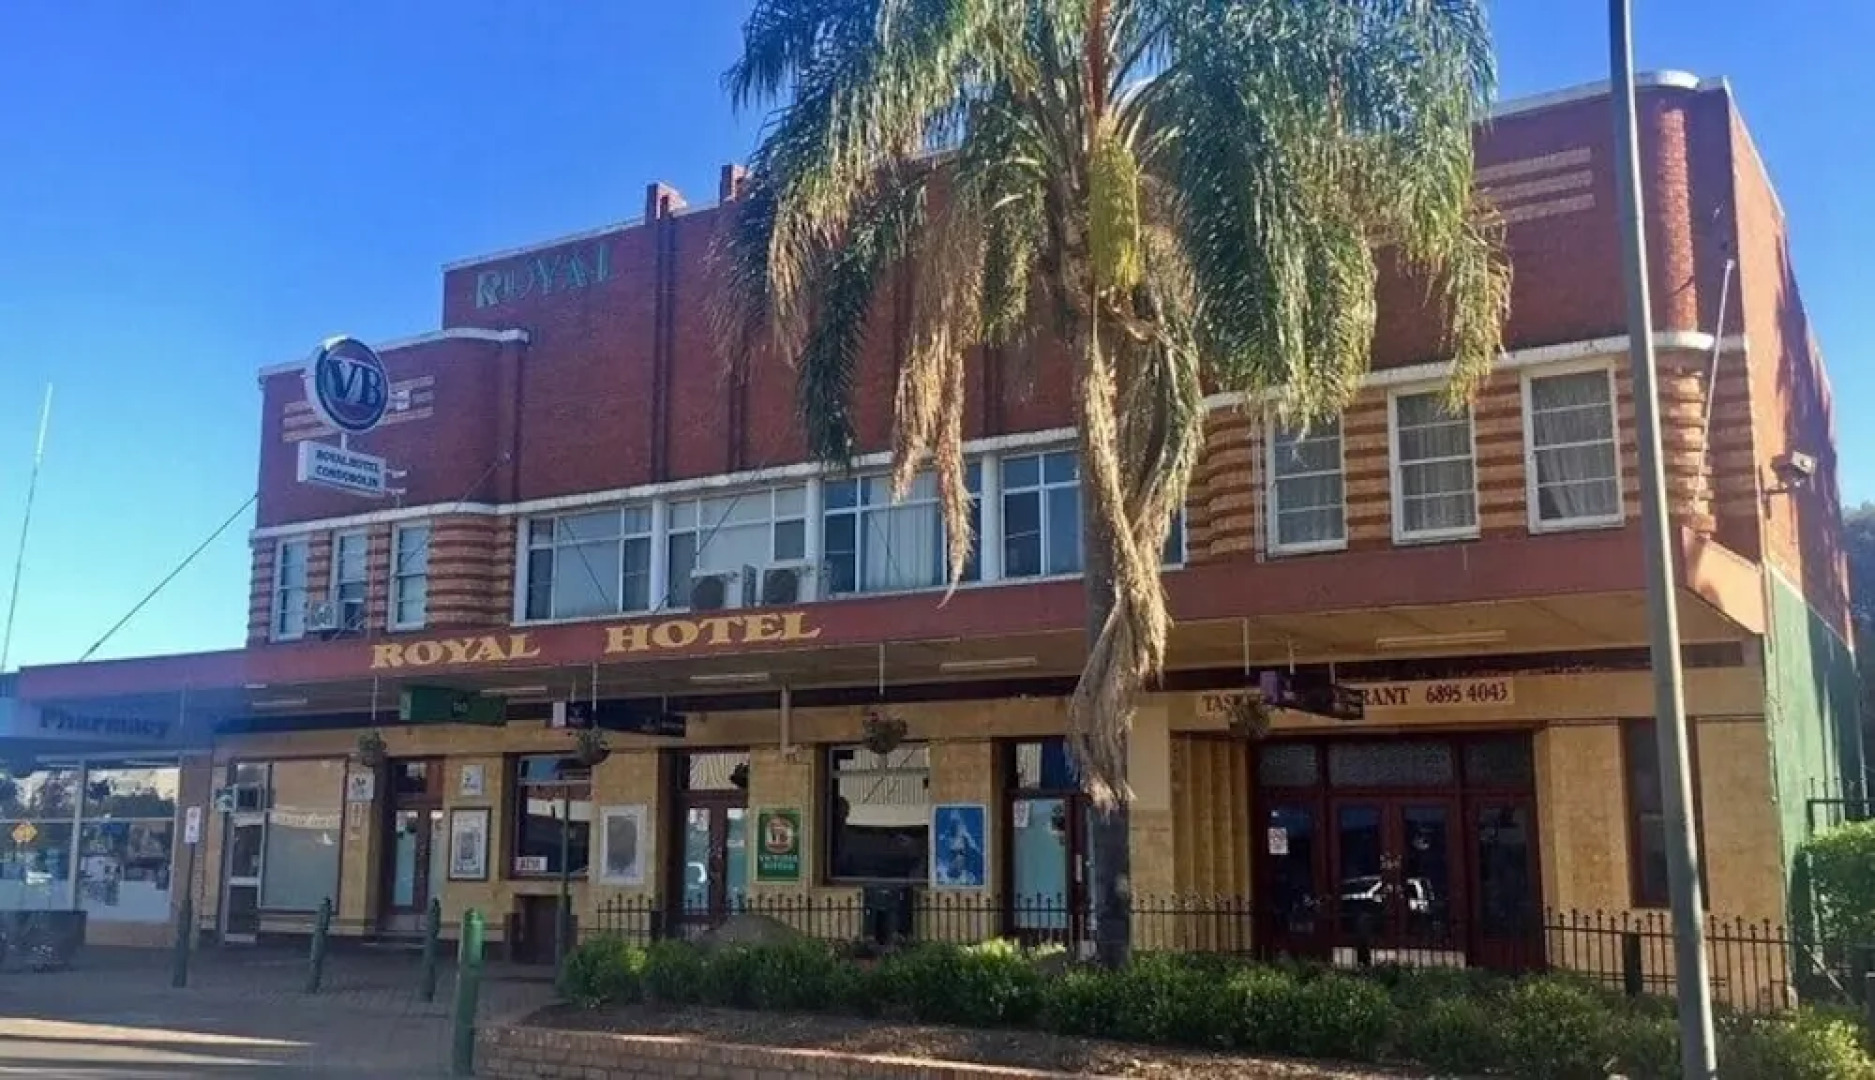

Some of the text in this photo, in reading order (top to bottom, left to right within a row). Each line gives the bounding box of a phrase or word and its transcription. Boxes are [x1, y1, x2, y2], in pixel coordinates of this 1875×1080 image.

[326, 357, 382, 406] VB
[315, 449, 347, 465] ROYAL
[315, 464, 379, 487] CONDOBOLIN
[369, 612, 822, 669] ROYAL HOTEL
[1425, 683, 1463, 704] 6895
[1466, 681, 1508, 704] 4043
[40, 705, 168, 739] Pharmacy
